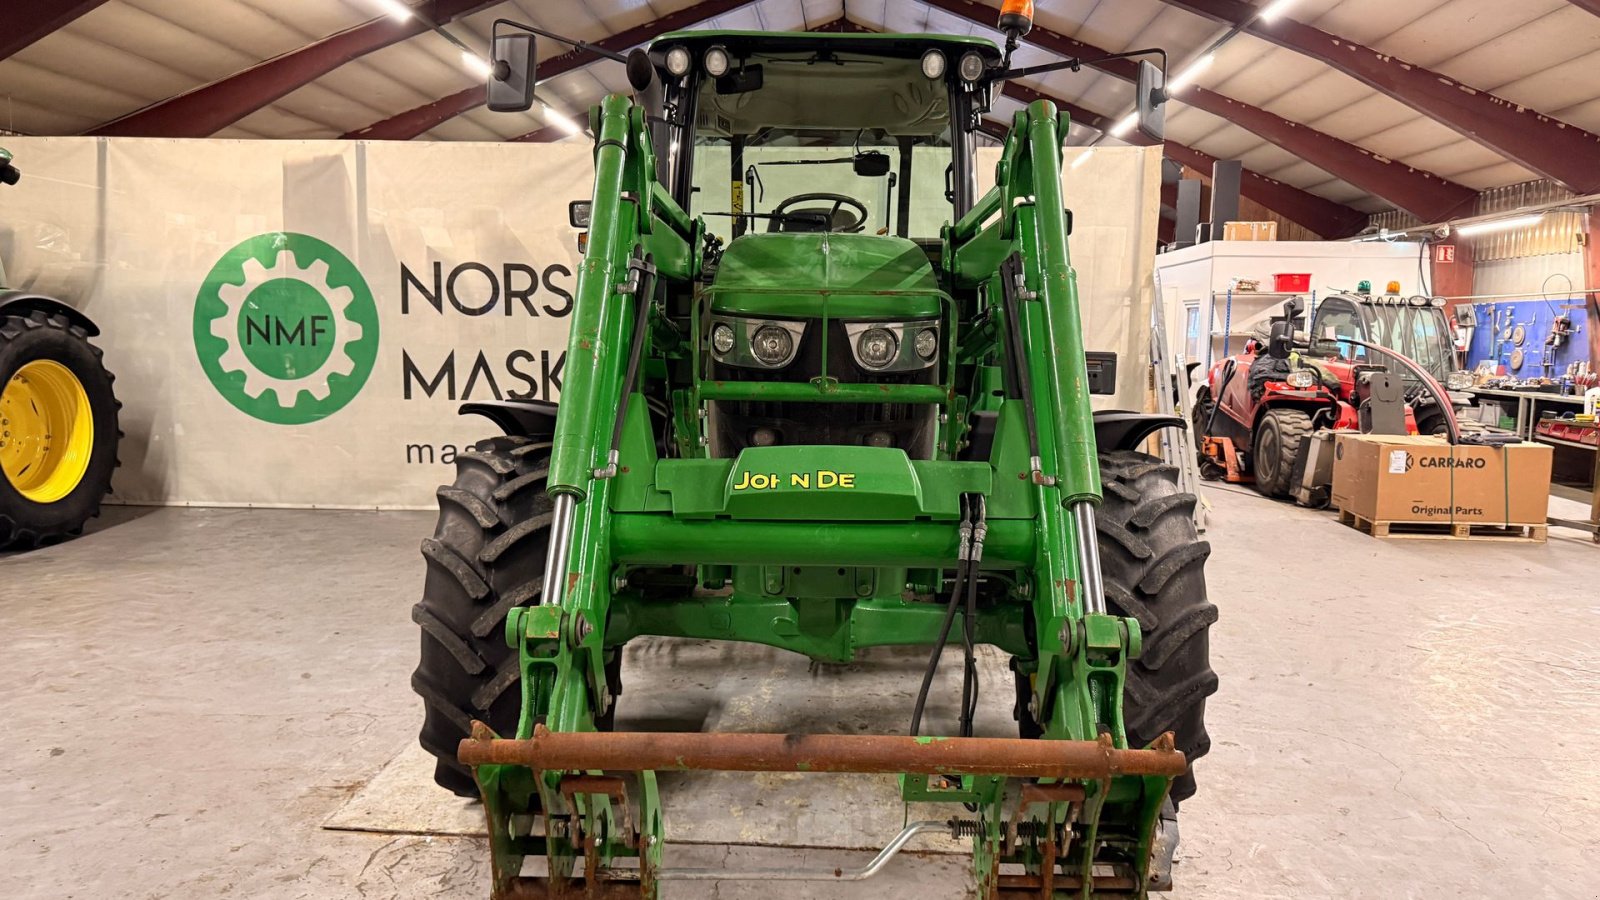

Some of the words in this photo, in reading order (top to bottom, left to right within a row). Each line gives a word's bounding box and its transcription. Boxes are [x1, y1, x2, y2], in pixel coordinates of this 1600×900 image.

[400, 261, 574, 318] NORS
[246, 314, 329, 346] NMF
[402, 347, 567, 401] MASK
[1419, 457, 1486, 469] CARRARO
[1411, 505, 1453, 516] Original
[1455, 506, 1483, 516] Parts
